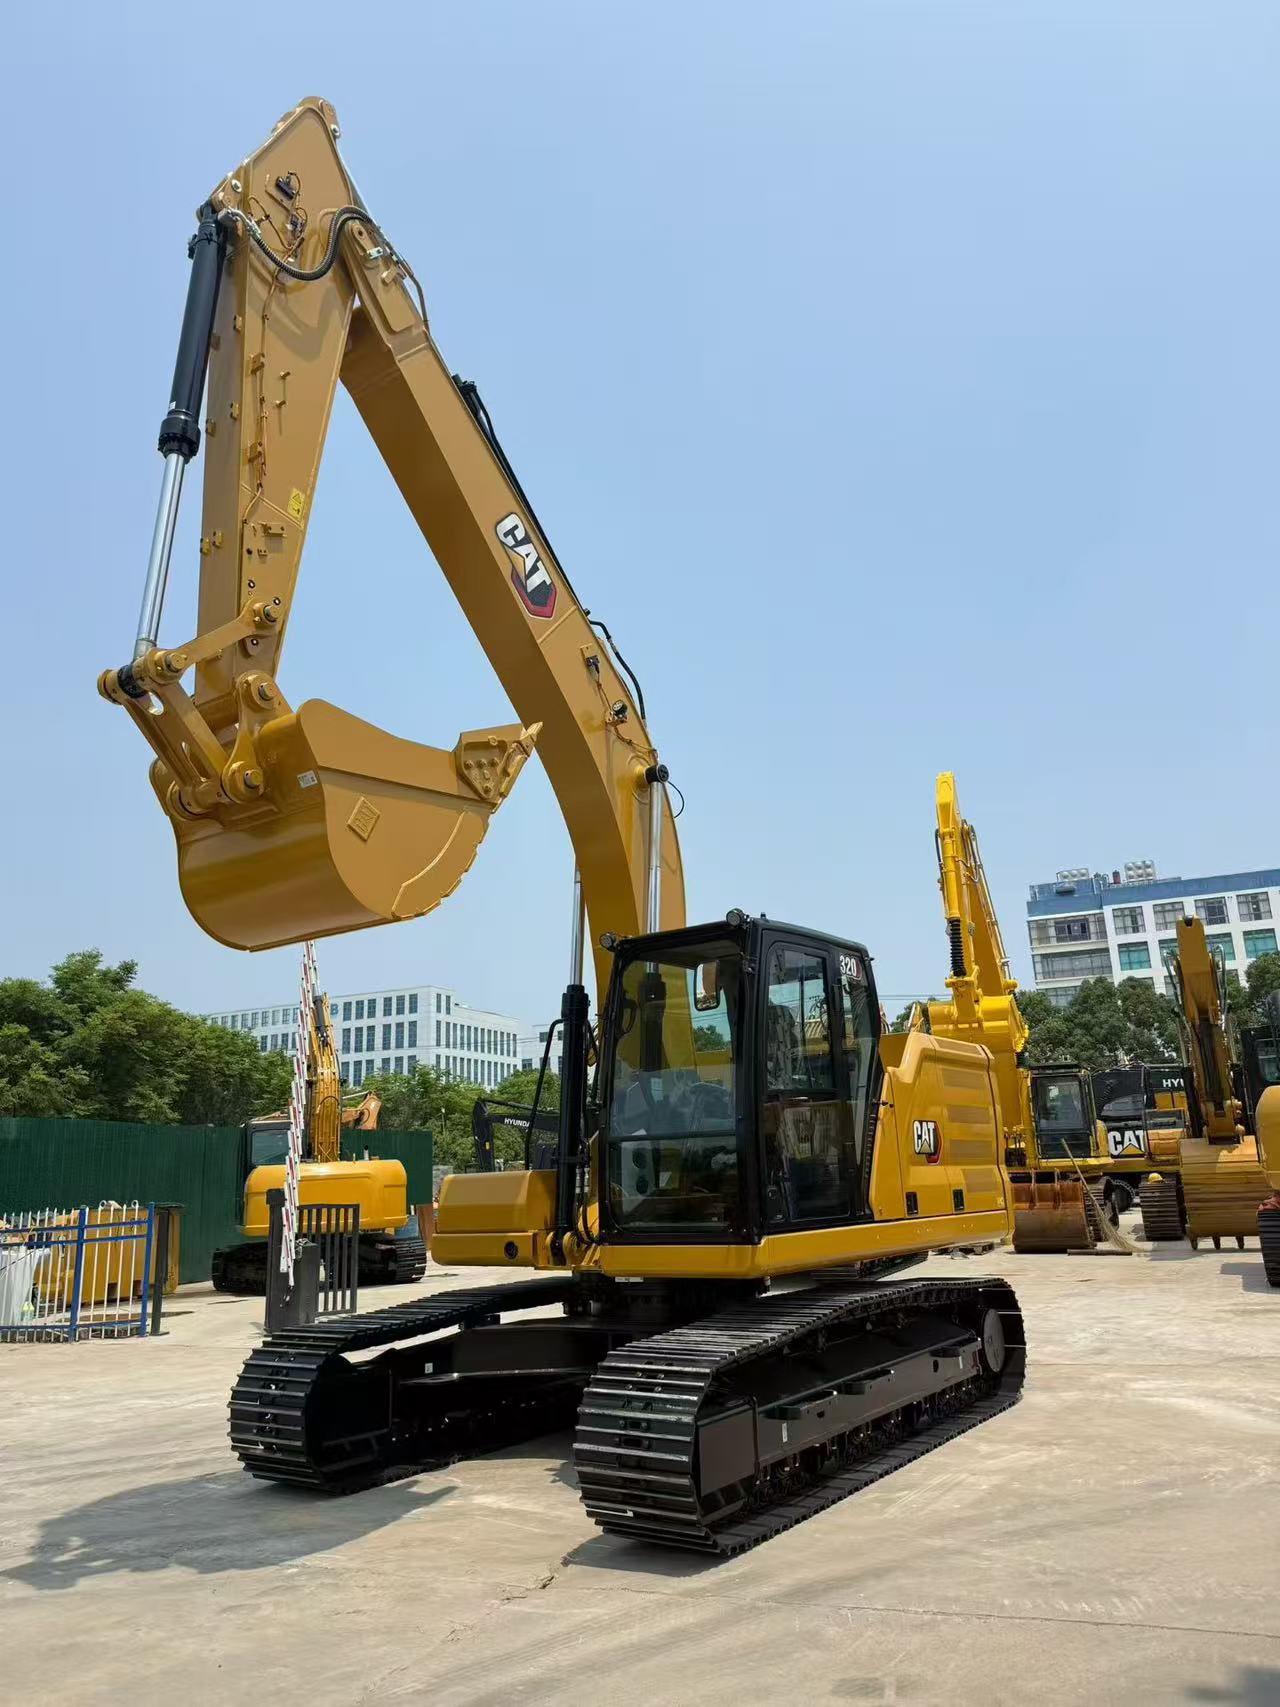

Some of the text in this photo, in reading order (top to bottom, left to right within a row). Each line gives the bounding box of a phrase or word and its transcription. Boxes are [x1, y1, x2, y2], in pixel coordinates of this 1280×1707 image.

[496, 513, 552, 593] CAT
[840, 954, 857, 977] 320
[913, 1120, 935, 1153] CAT
[1108, 1129, 1145, 1156] CAT
